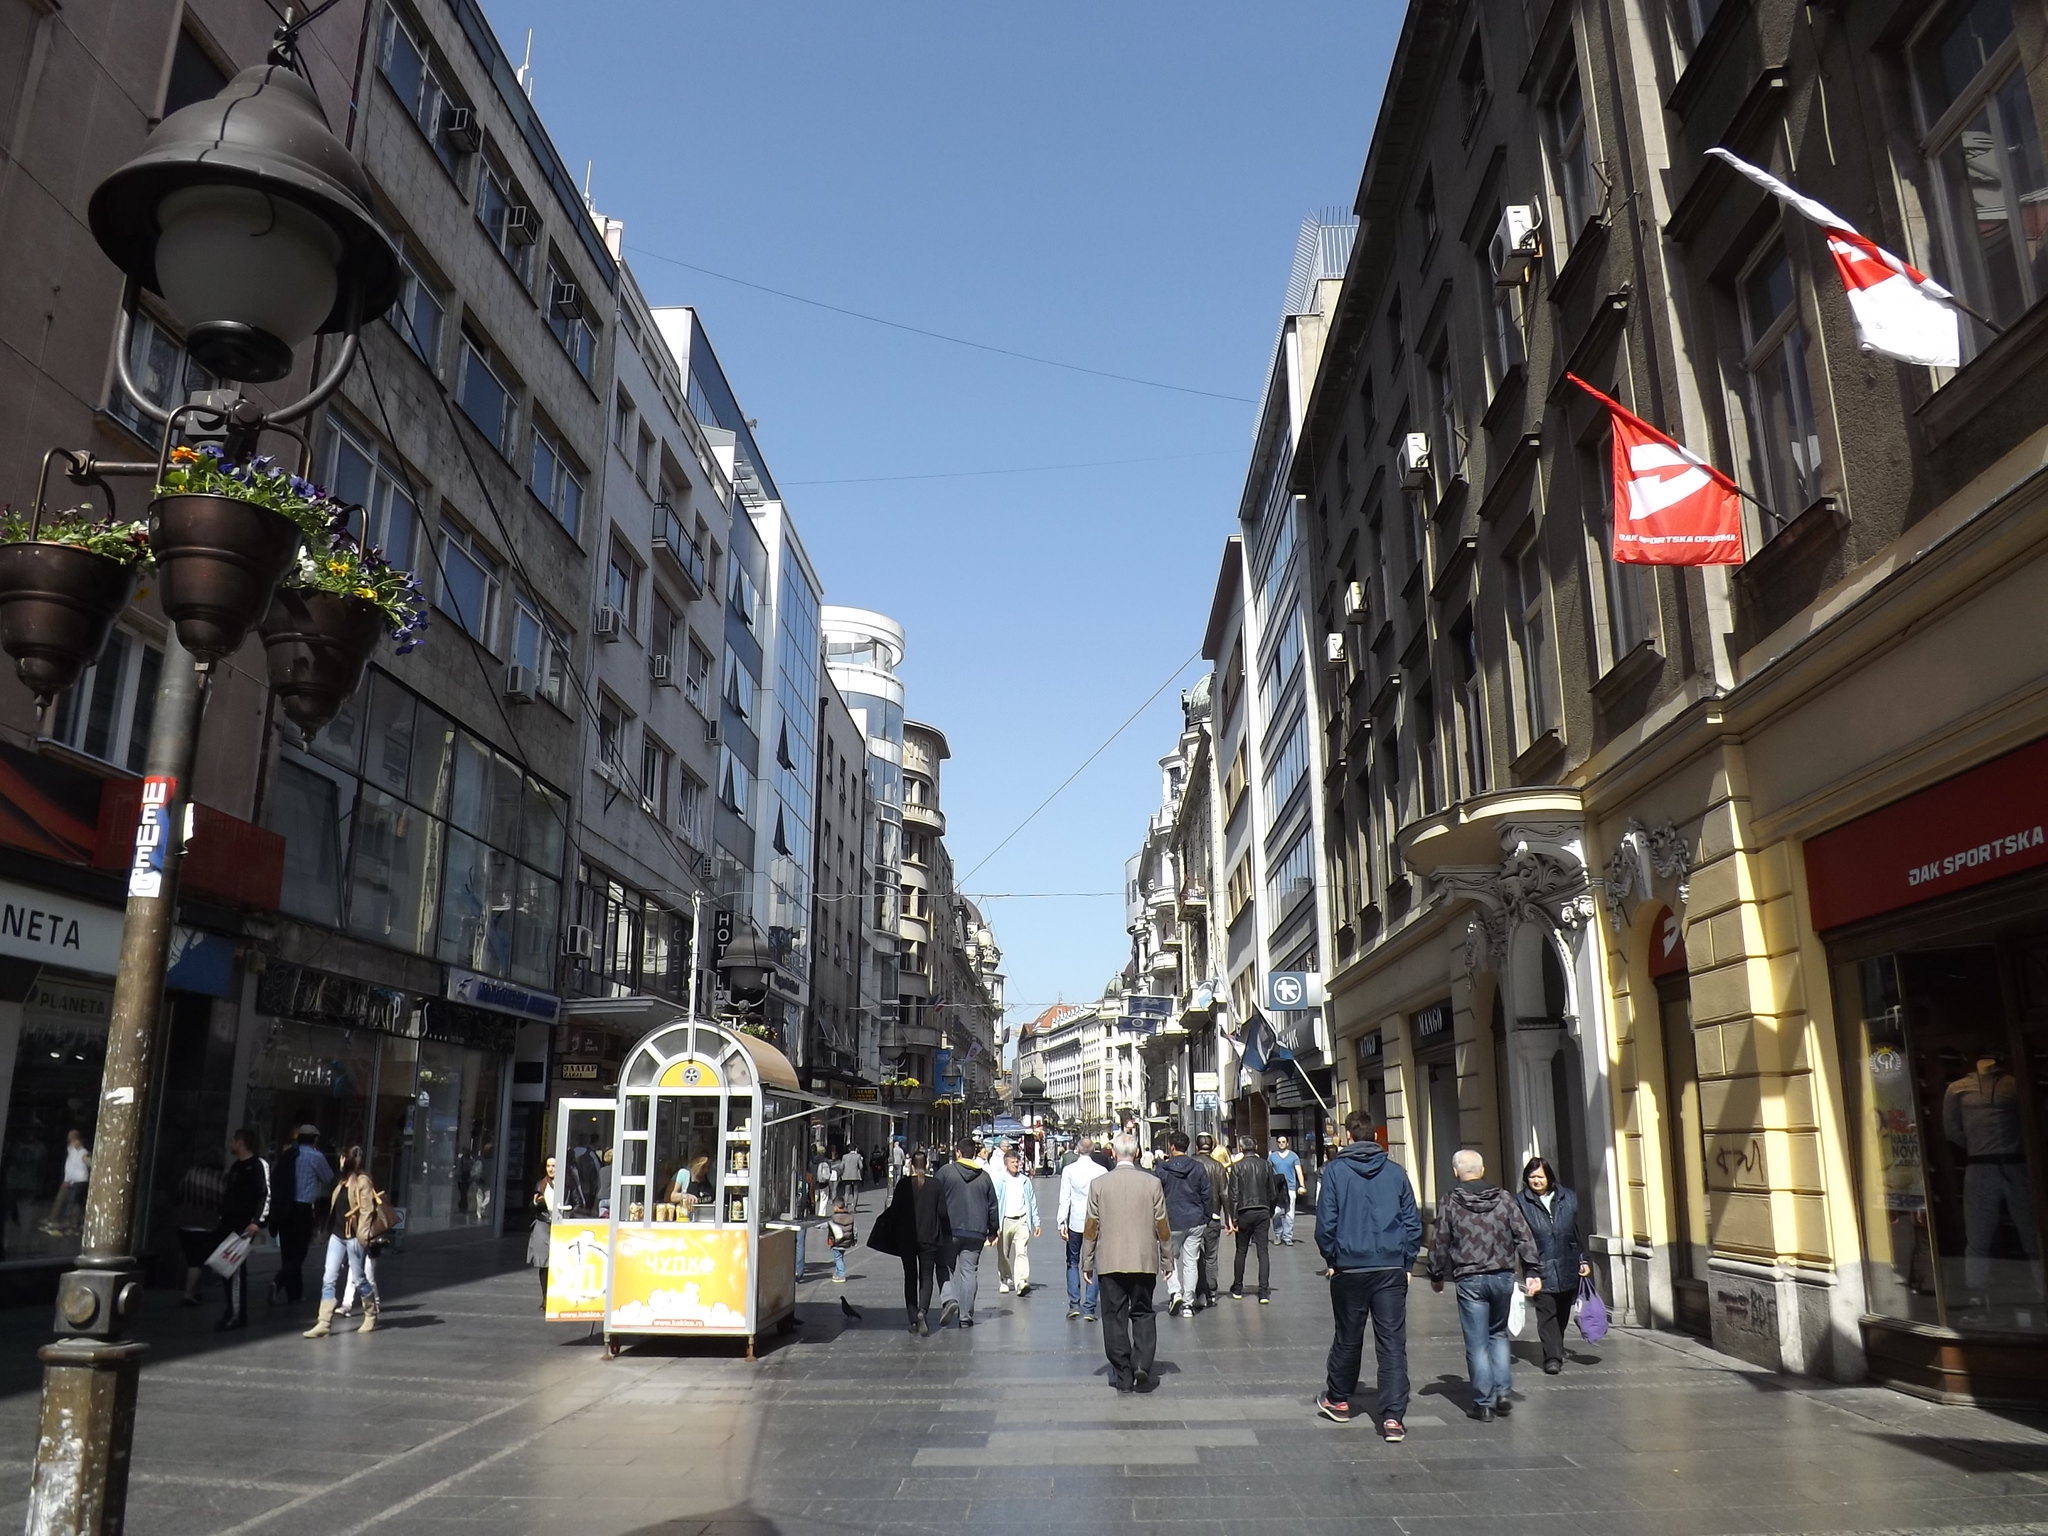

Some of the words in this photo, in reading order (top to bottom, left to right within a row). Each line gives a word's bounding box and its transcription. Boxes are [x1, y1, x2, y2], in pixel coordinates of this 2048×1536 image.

[1943, 826, 2045, 875] SPORTSKA
[40, 992, 105, 1015] PLANETA
[1418, 1008, 1442, 1036] MANGO
